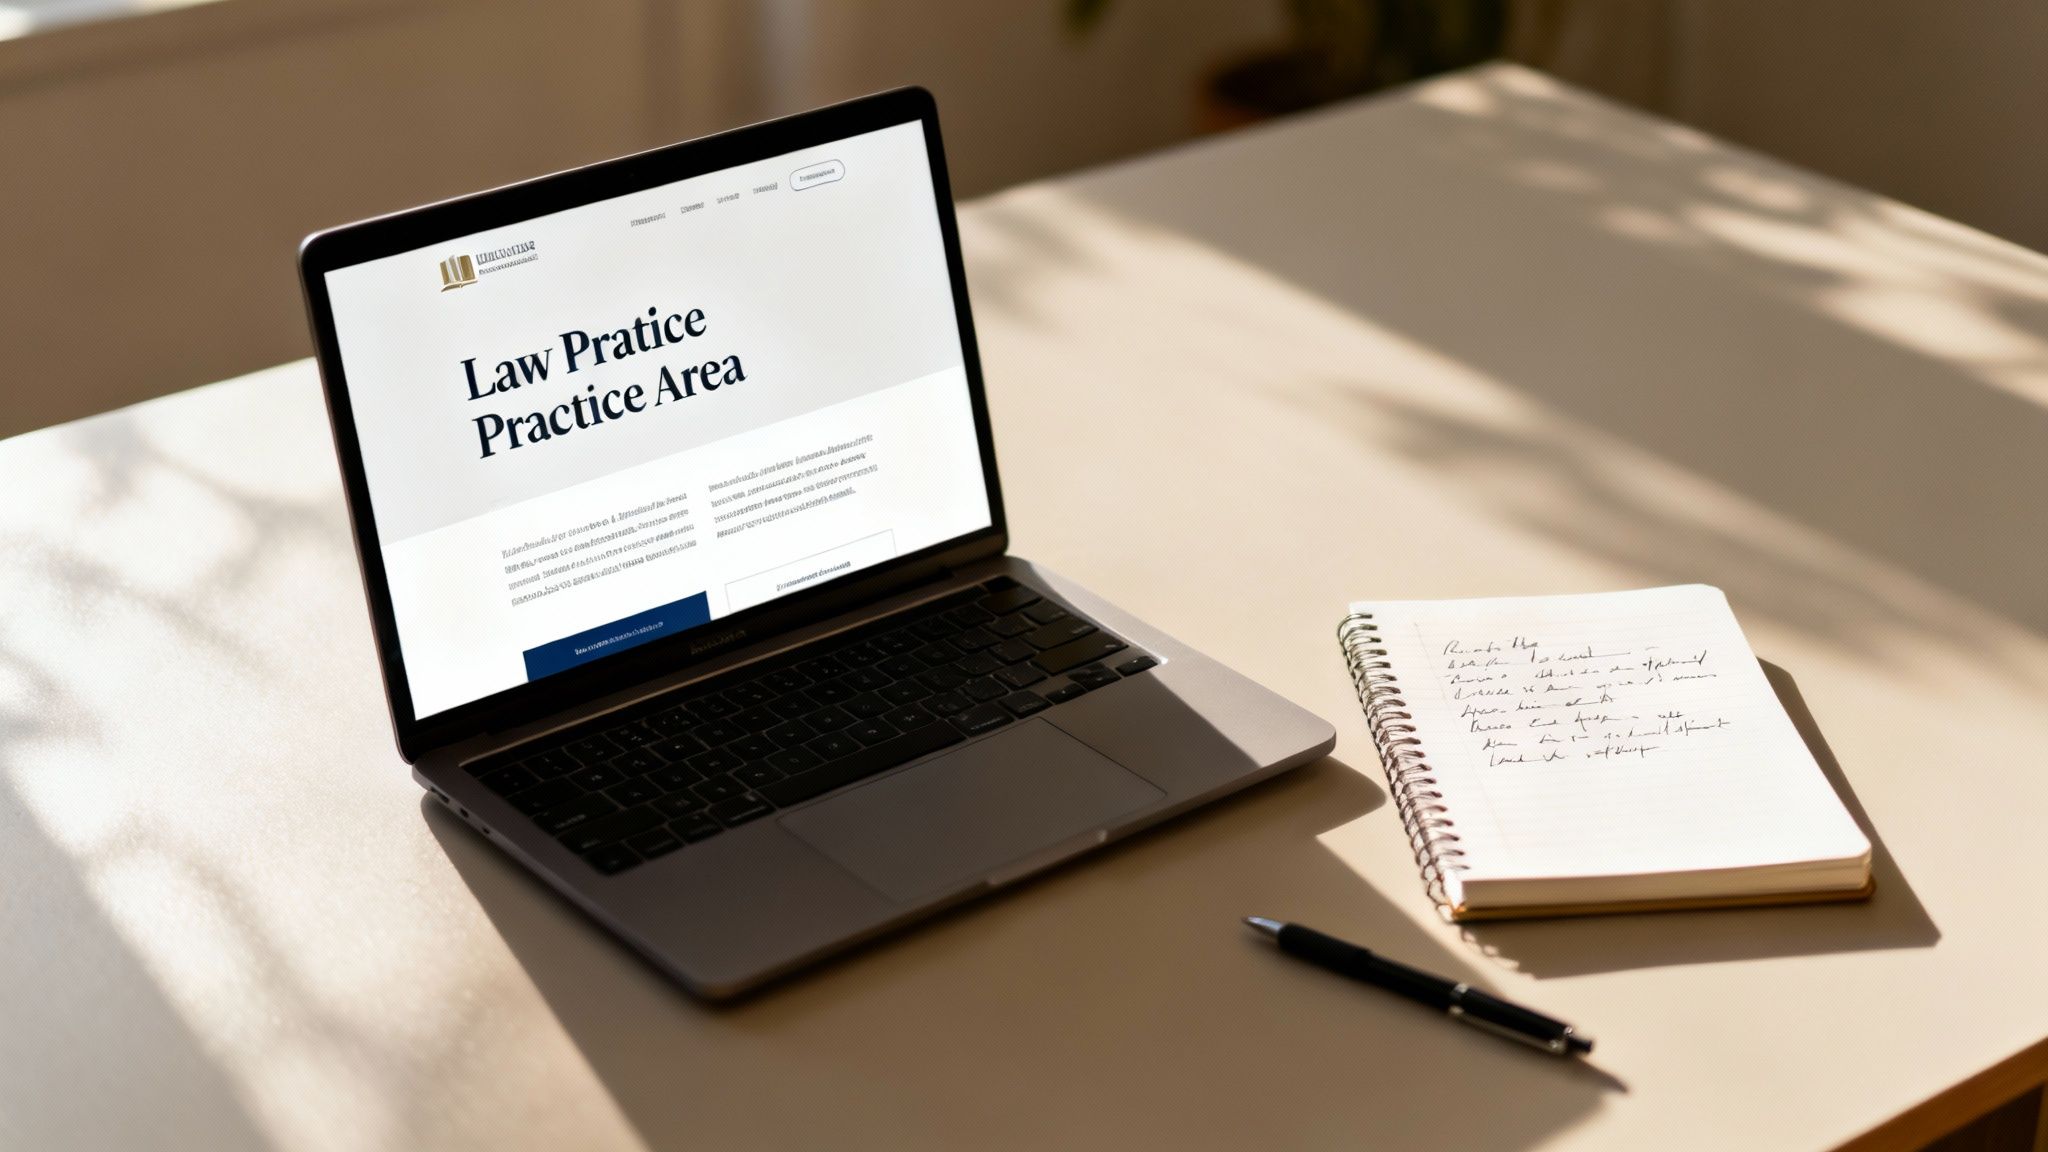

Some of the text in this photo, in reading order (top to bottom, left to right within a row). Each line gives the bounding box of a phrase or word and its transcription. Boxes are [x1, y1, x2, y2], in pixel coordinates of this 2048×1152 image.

[460, 306, 707, 401] Law Pratice
[471, 355, 746, 459] Practice Area
